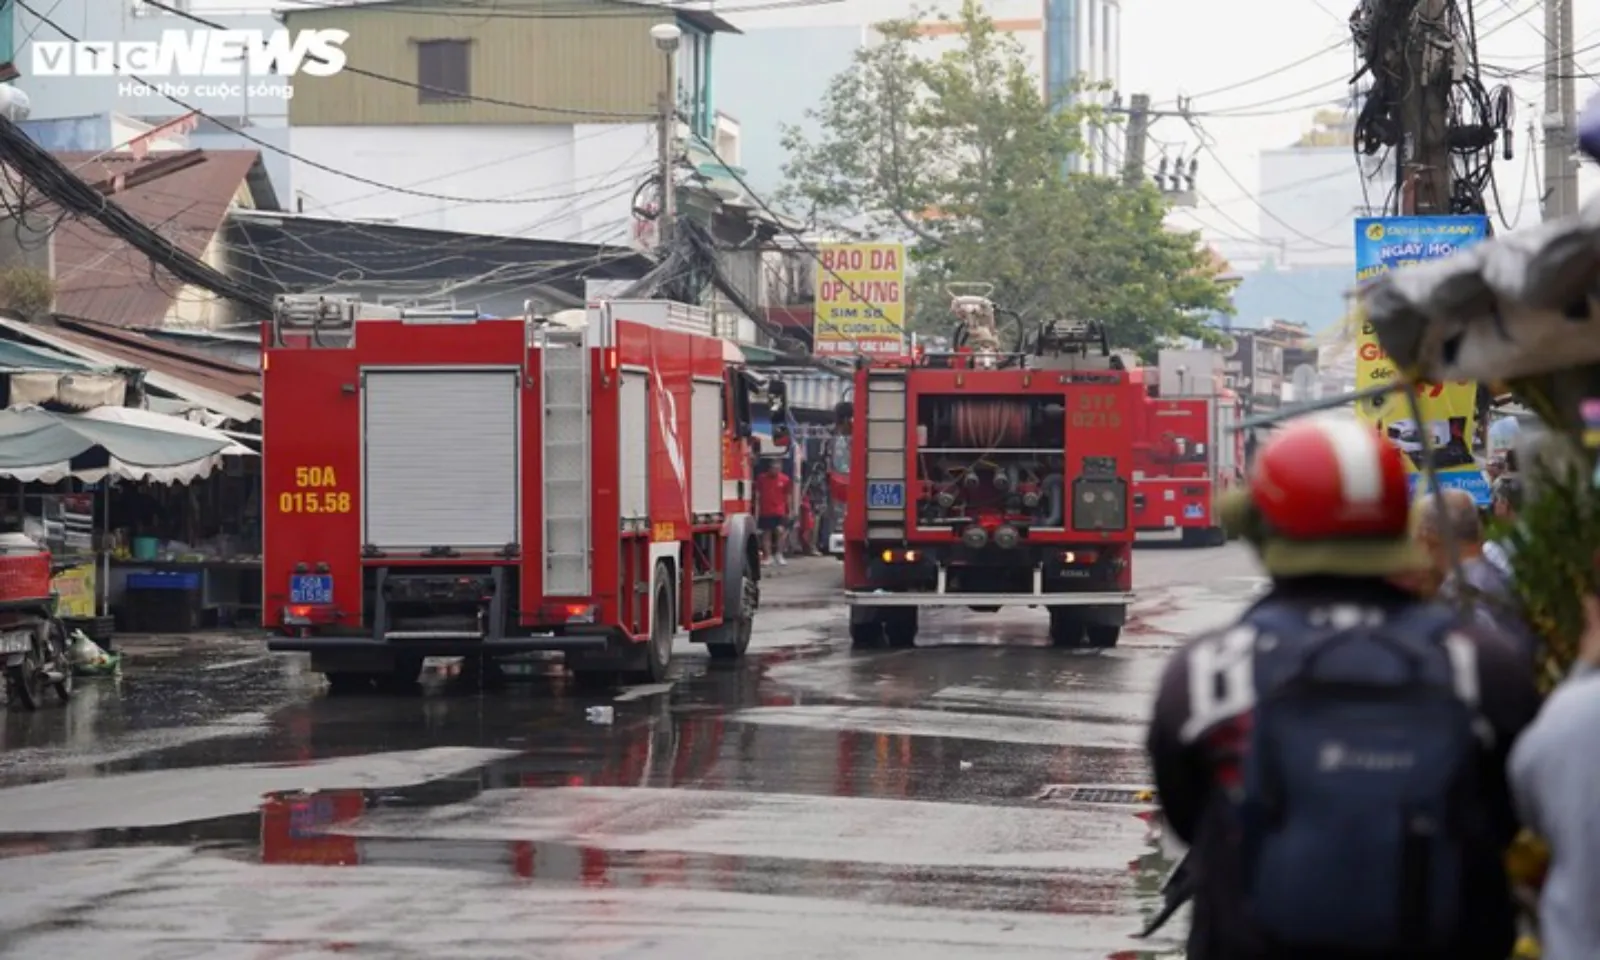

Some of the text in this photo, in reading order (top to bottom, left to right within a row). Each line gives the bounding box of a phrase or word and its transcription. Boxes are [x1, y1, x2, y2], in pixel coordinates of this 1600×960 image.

[823, 249, 897, 271] BAO DA
[295, 466, 337, 487] 50A
[279, 492, 351, 513] 015.58
